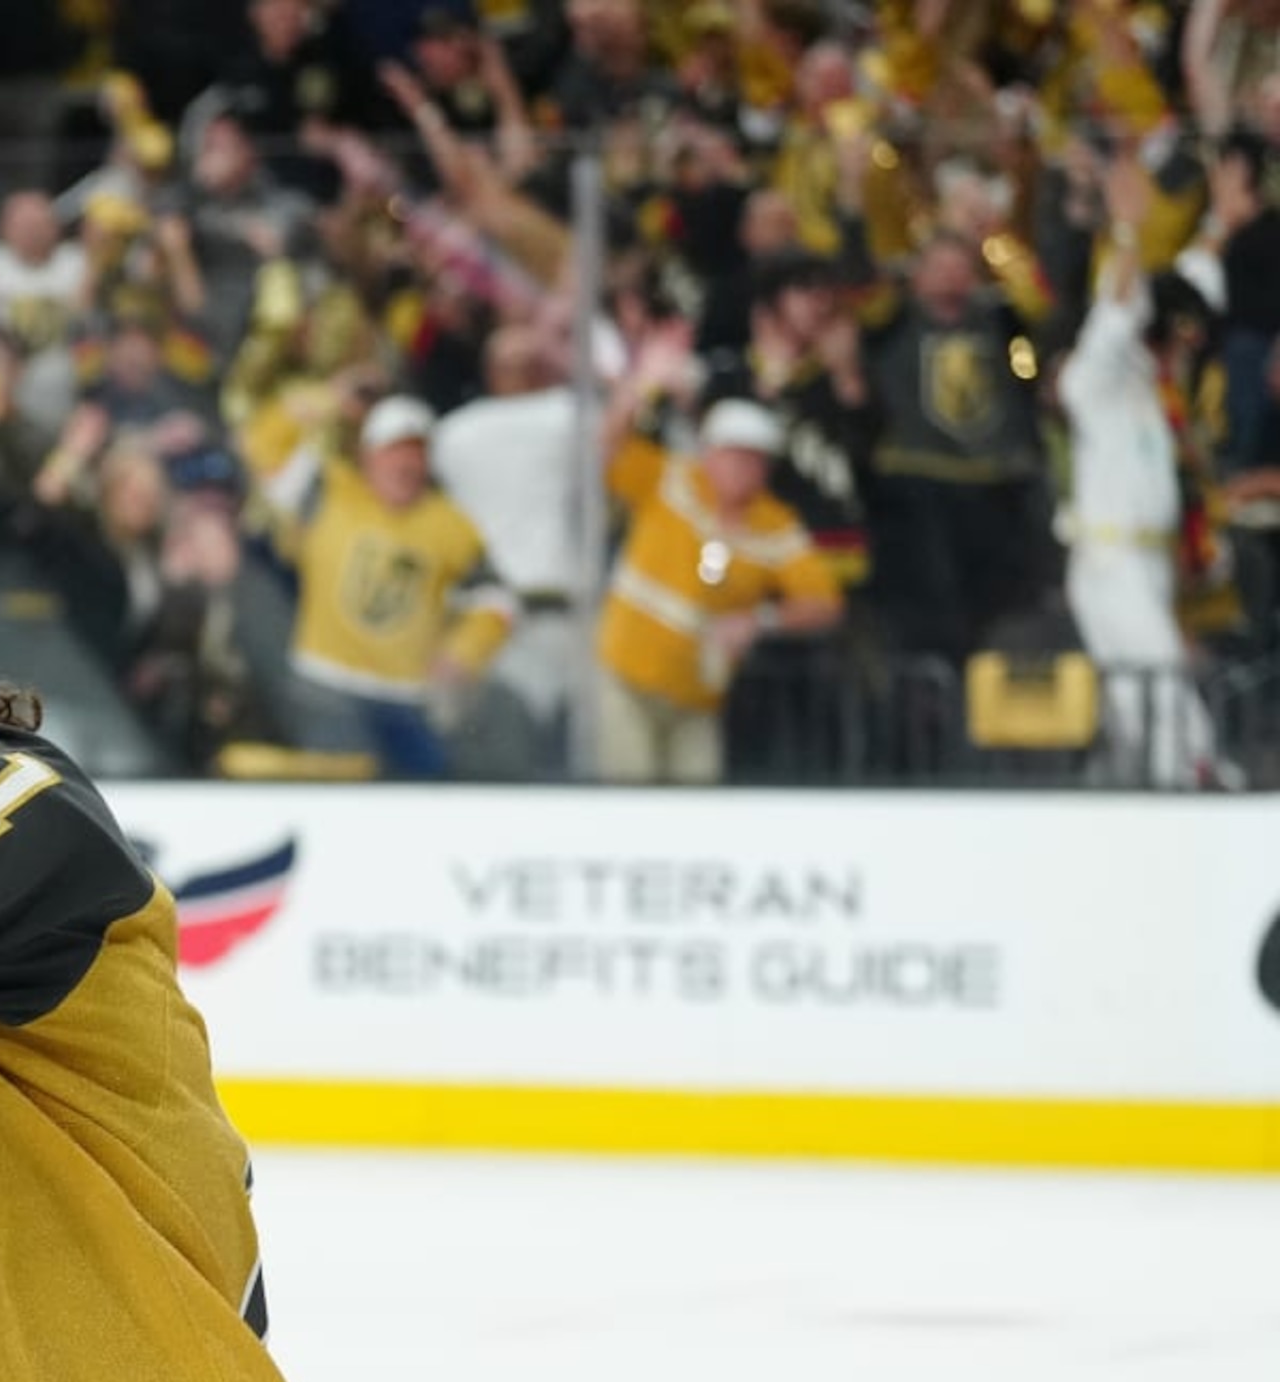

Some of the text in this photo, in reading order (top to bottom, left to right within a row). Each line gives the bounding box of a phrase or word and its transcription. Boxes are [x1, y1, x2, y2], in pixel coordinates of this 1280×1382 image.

[453, 860, 863, 920] VETERAN
[313, 938, 1000, 1007] BENEFITS GUIDE
